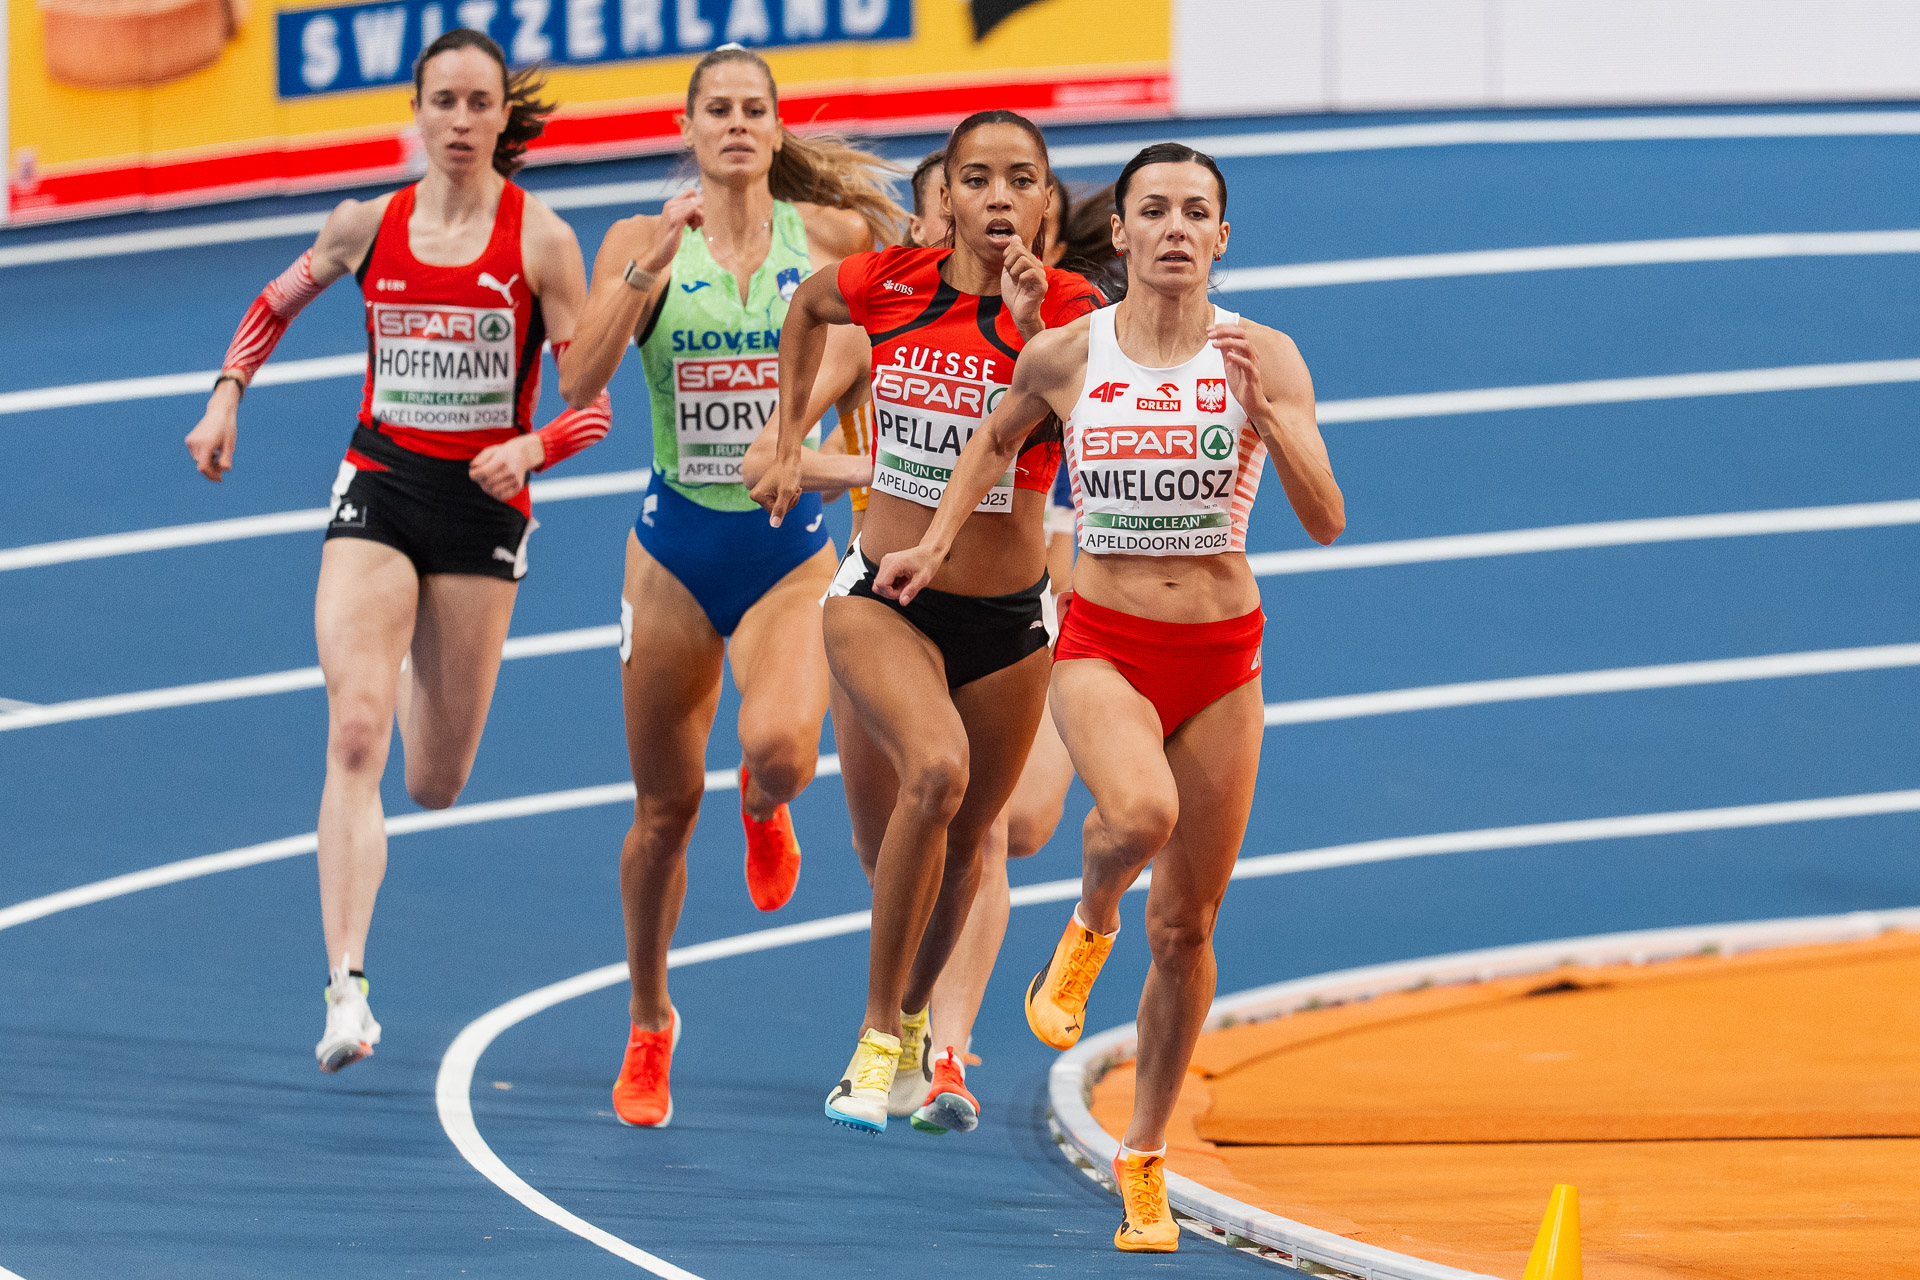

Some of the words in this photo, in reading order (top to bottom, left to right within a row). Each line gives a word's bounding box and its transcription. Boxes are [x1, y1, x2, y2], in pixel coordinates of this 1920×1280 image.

[893, 283, 914, 296] UBS
[379, 312, 473, 339] SPAR
[671, 329, 781, 352] SLOVEN
[379, 348, 509, 380] HOFFMANN
[680, 362, 779, 388] SPAR
[407, 393, 433, 404] RUN
[879, 374, 982, 413] SPAR
[1088, 381, 1131, 403] 4F
[1138, 399, 1179, 411] ORLEN
[379, 409, 470, 424] APELDOORN
[474, 410, 508, 423] 2025
[879, 409, 974, 456] PELLA
[1085, 429, 1194, 456] SPAR
[716, 444, 746, 456] RUN
[904, 461, 930, 477] RUN
[932, 468, 952, 480] CL
[878, 471, 945, 501] APELDOO
[1080, 469, 1233, 501] WIELGOSZ
[1111, 515, 1116, 527] I
[1118, 516, 1149, 529] RUN
[1086, 533, 1190, 550] APELDOORN
[1194, 533, 1228, 549] 2025
